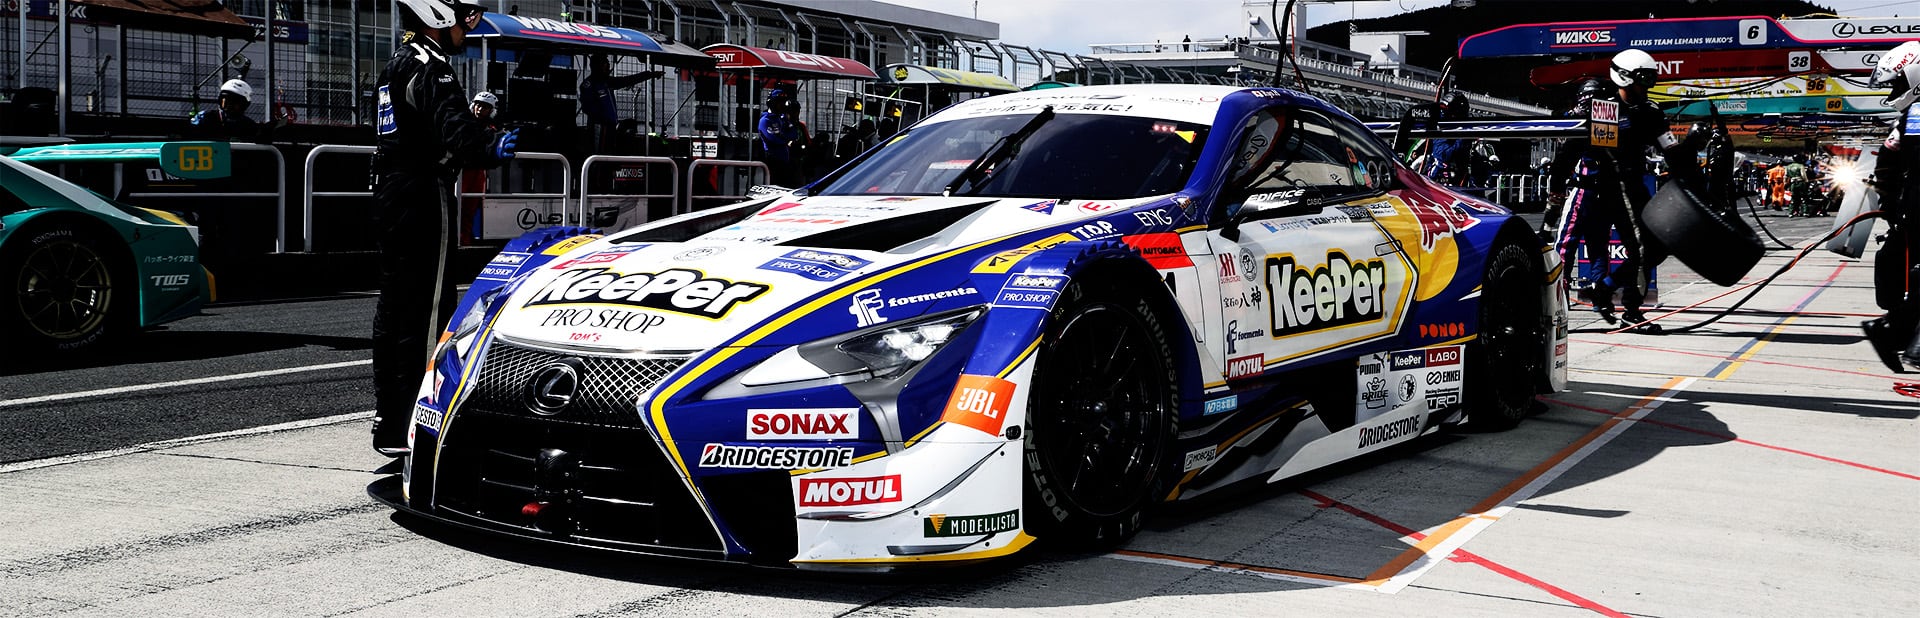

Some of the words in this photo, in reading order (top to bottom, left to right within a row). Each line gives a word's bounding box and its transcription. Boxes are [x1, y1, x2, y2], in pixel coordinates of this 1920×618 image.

[1747, 25, 1759, 40] 6
[1858, 25, 1920, 35] LEXUS
[1630, 39, 1652, 47] LEXUS
[1654, 38, 1673, 46] TEAM
[1704, 36, 1733, 44] WAKO'S
[1790, 56, 1809, 68] 38
[1892, 52, 1914, 74] TOM'S
[1807, 80, 1825, 91] 96
[1593, 101, 1617, 121] SONAX
[1827, 100, 1841, 109] 60
[179, 146, 213, 171] GB
[1249, 188, 1306, 201] EDIFICE
[1133, 208, 1172, 227] ENG
[1143, 246, 1182, 255] AUTOBACS
[793, 251, 862, 268] KeePer
[770, 261, 800, 272] PRO
[799, 263, 839, 279] SHOP
[150, 274, 190, 287] TWS
[1012, 275, 1063, 289] KeePer
[524, 267, 768, 318] KeePer
[888, 286, 978, 307] formenta
[1003, 293, 1024, 302] PRO
[1024, 293, 1052, 305] SHOP
[1268, 256, 1384, 331] KeePer
[540, 308, 592, 327] PRO
[591, 310, 665, 334] SHOP
[568, 332, 602, 342] TOM'S
[1238, 329, 1265, 341] formenta
[1419, 322, 1465, 338] PONOS
[1395, 355, 1422, 367] KeePer
[1429, 351, 1457, 363] LABO
[1229, 357, 1262, 378] MOTUL
[1360, 363, 1381, 375] PUMA
[1442, 370, 1460, 382] ENKEI
[1362, 390, 1389, 400] BRIDE
[1426, 395, 1458, 410] TRD
[957, 387, 998, 419] JBL
[751, 414, 849, 435] SONAX
[1358, 414, 1420, 449] BRIDGESTONE
[701, 445, 852, 468] BRIDGESTONE
[804, 478, 899, 503] MOTUL
[950, 513, 1016, 534] MODELLISTA
